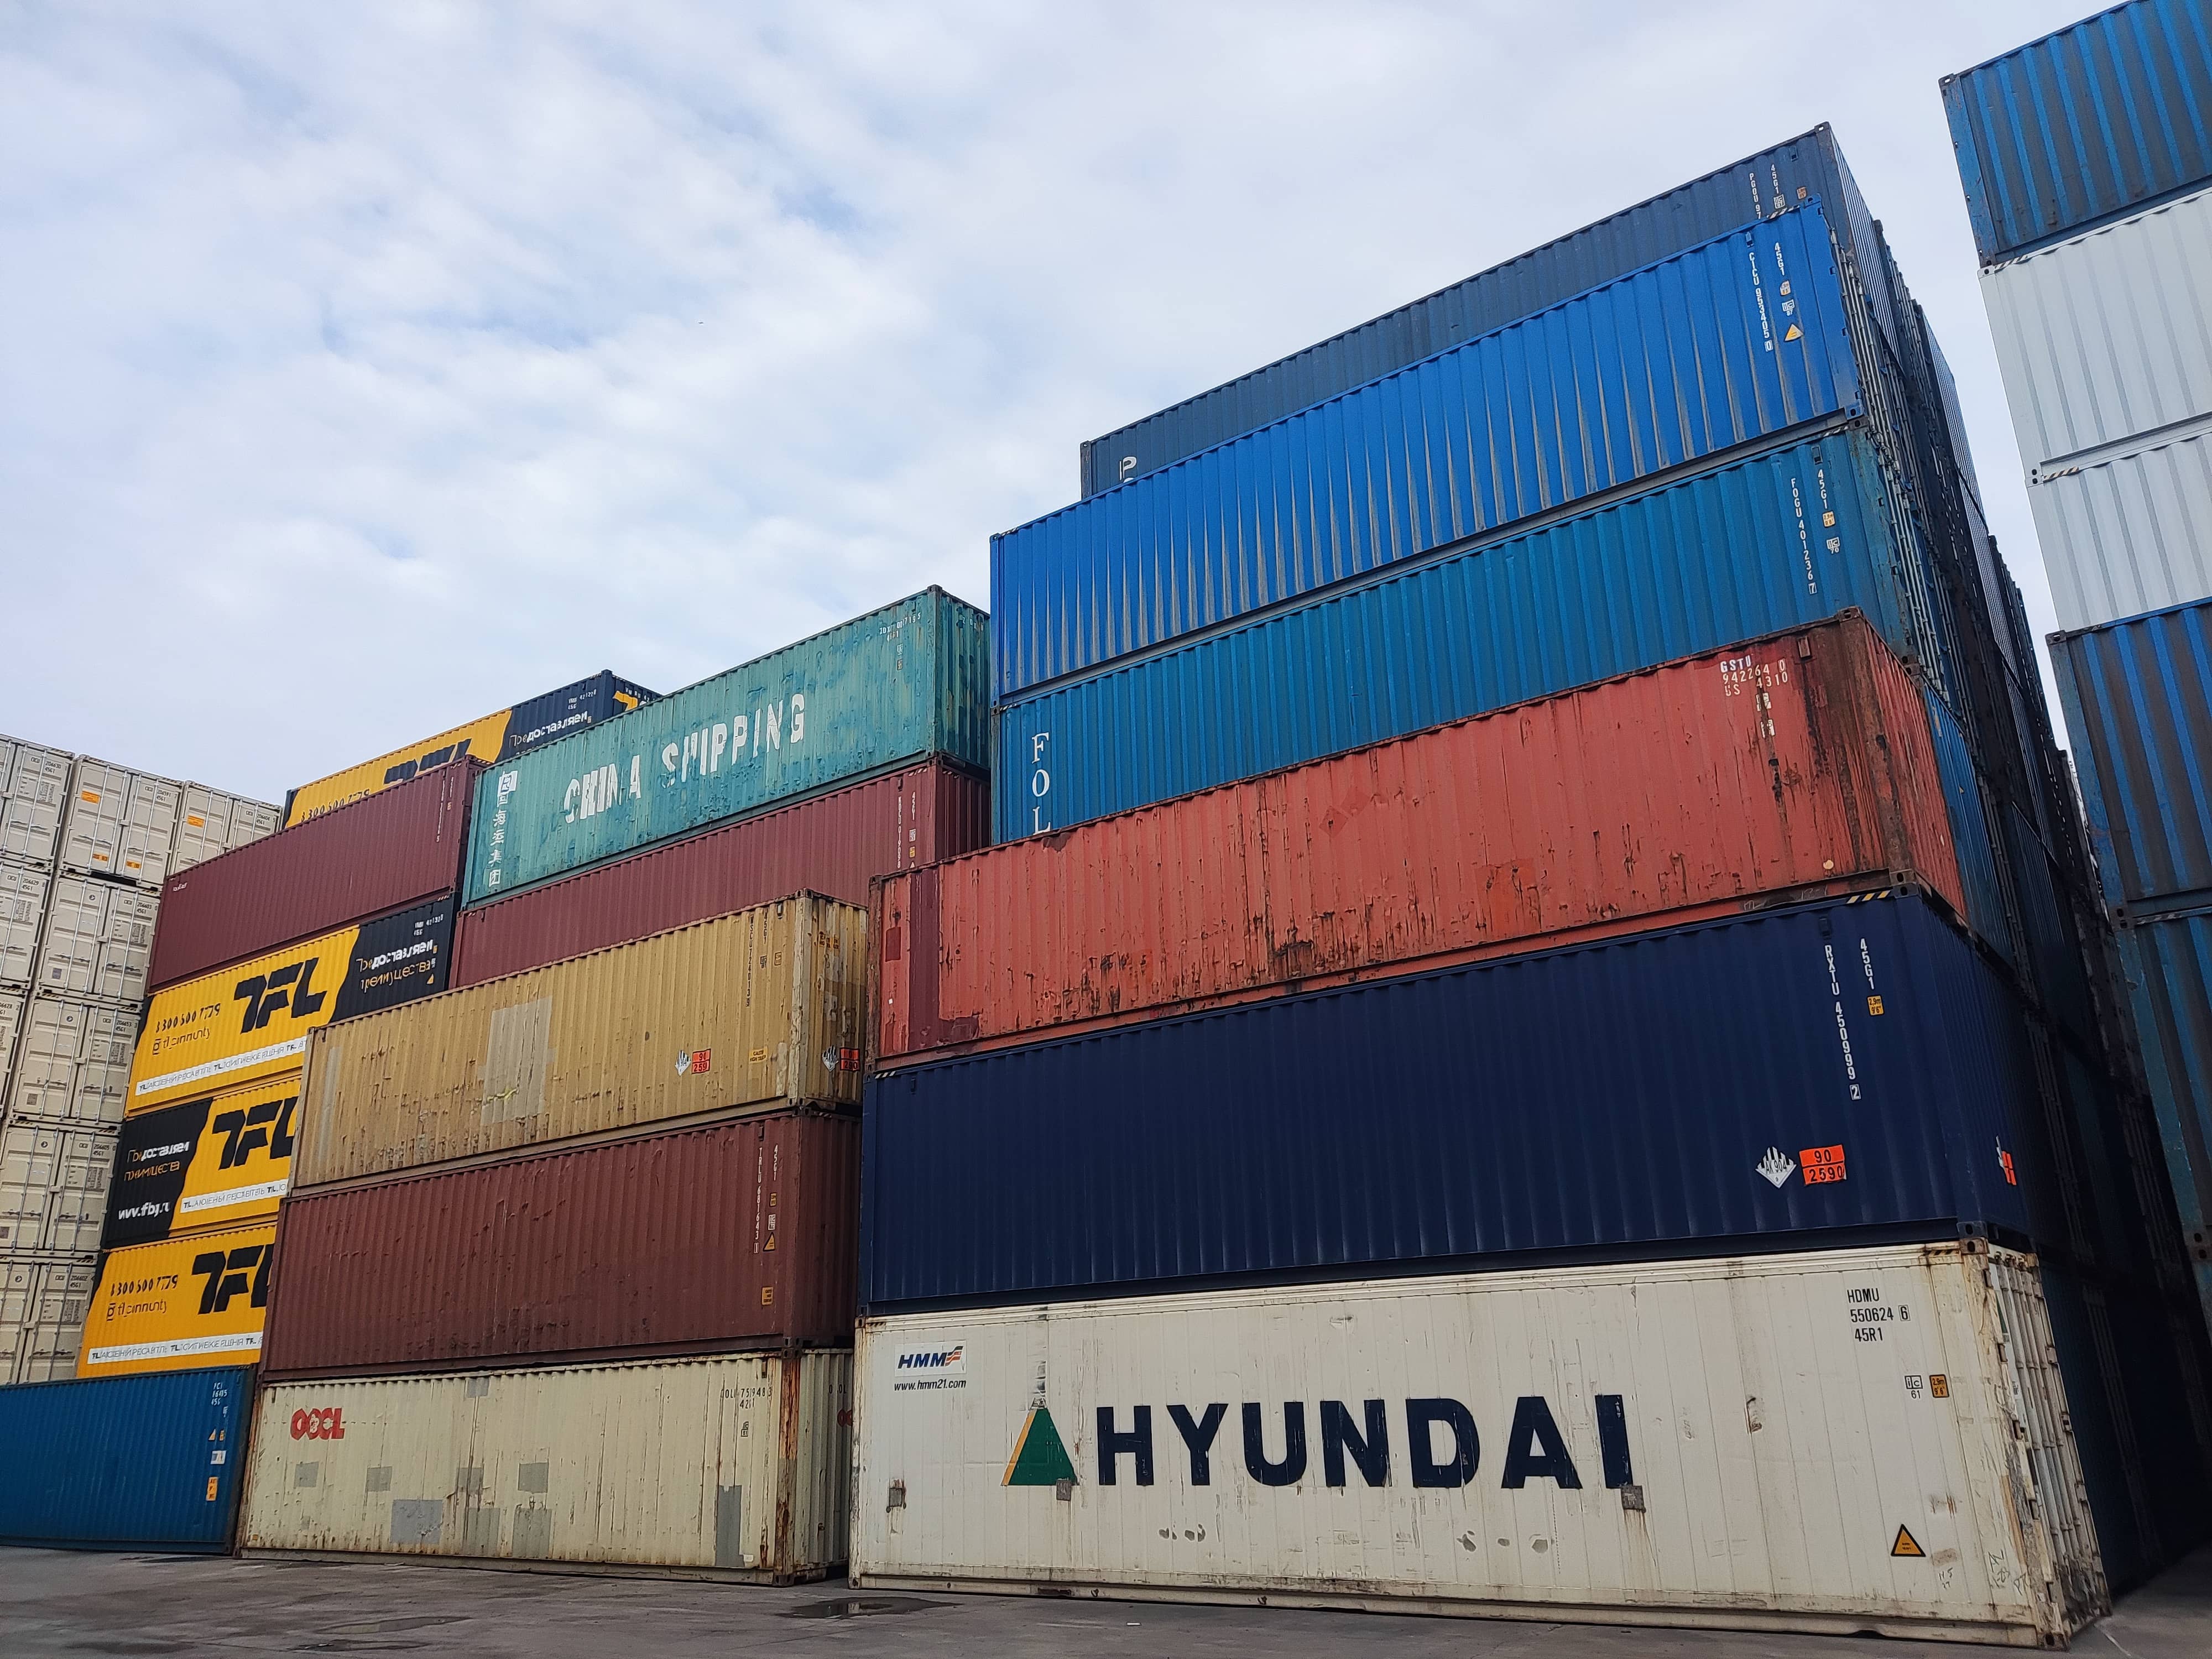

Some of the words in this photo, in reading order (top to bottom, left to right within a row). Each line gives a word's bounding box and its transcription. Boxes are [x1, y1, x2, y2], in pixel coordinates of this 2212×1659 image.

[1749, 173, 1758, 202] PGOU
[1774, 242, 1785, 276] 45G1
[1749, 252, 1760, 286] CICU
[1755, 288, 1770, 339] 953405
[1119, 456, 1137, 483] P
[1817, 469, 1828, 509] 45G1
[1791, 477, 1802, 518] FOGU
[1798, 519, 1813, 581] 401236
[1720, 655, 1751, 673] GSTU
[1723, 664, 1770, 685] 942264
[1779, 659, 1786, 672] 0
[1724, 684, 1740, 696] US
[1756, 671, 1788, 688] 4310
[661, 693, 805, 789] SHIPPING
[45, 760, 61, 769] 206630
[564, 754, 641, 823] CHINA
[1860, 938, 1875, 990] 45G1
[233, 957, 328, 1034] TFL
[1825, 944, 1840, 995] RXTU
[1835, 1001, 1856, 1079] 450999
[1775, 1158, 1787, 1173] 904
[1814, 1149, 1832, 1164] 90
[1809, 1165, 1843, 1182] 2590
[1847, 1287, 1880, 1303] HDMU
[1850, 1306, 1894, 1323] 550624
[1900, 1305, 1910, 1321] 6
[1855, 1327, 1884, 1342] 45R1
[897, 1352, 948, 1369] HMM
[894, 1378, 967, 1391] www.hmm21.com
[1911, 1390, 1922, 1399] 61
[290, 1407, 346, 1441] OOCL
[1097, 1394, 1634, 1489] HYUNDAI
